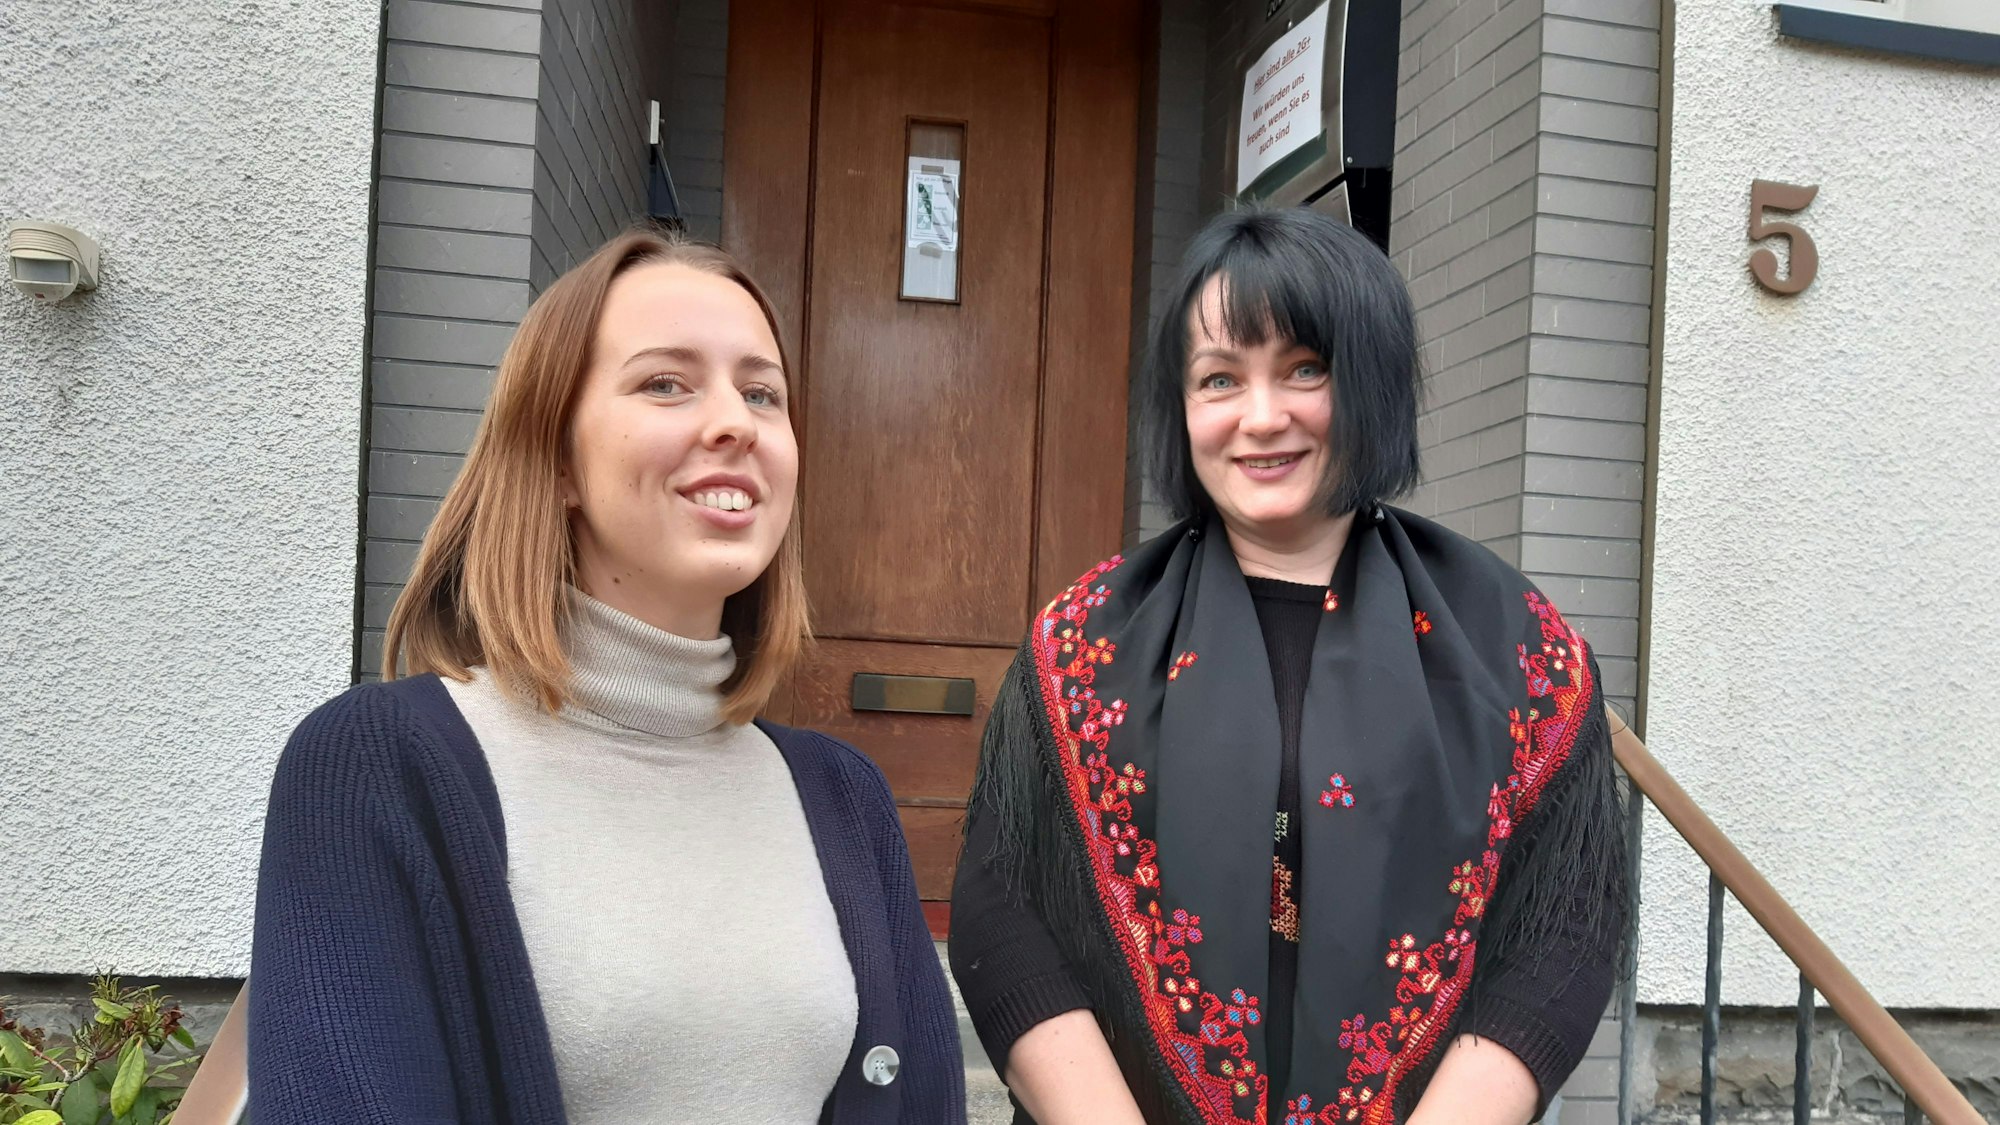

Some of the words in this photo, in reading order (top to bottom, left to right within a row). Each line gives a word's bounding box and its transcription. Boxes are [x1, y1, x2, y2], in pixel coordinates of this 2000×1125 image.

[1266, 57, 1280, 78] sind
[1281, 49, 1295, 66] alle
[1296, 36, 1311, 54] 2G+
[1252, 103, 1263, 121] Wir
[1264, 84, 1290, 111] würden
[1291, 73, 1305, 90] uns
[1268, 107, 1288, 127] wenn
[1289, 95, 1300, 112] Sie
[1301, 90, 1310, 103] es
[1259, 135, 1274, 155] auch
[1275, 121, 1290, 143] sind
[1749, 179, 1819, 294] 5
